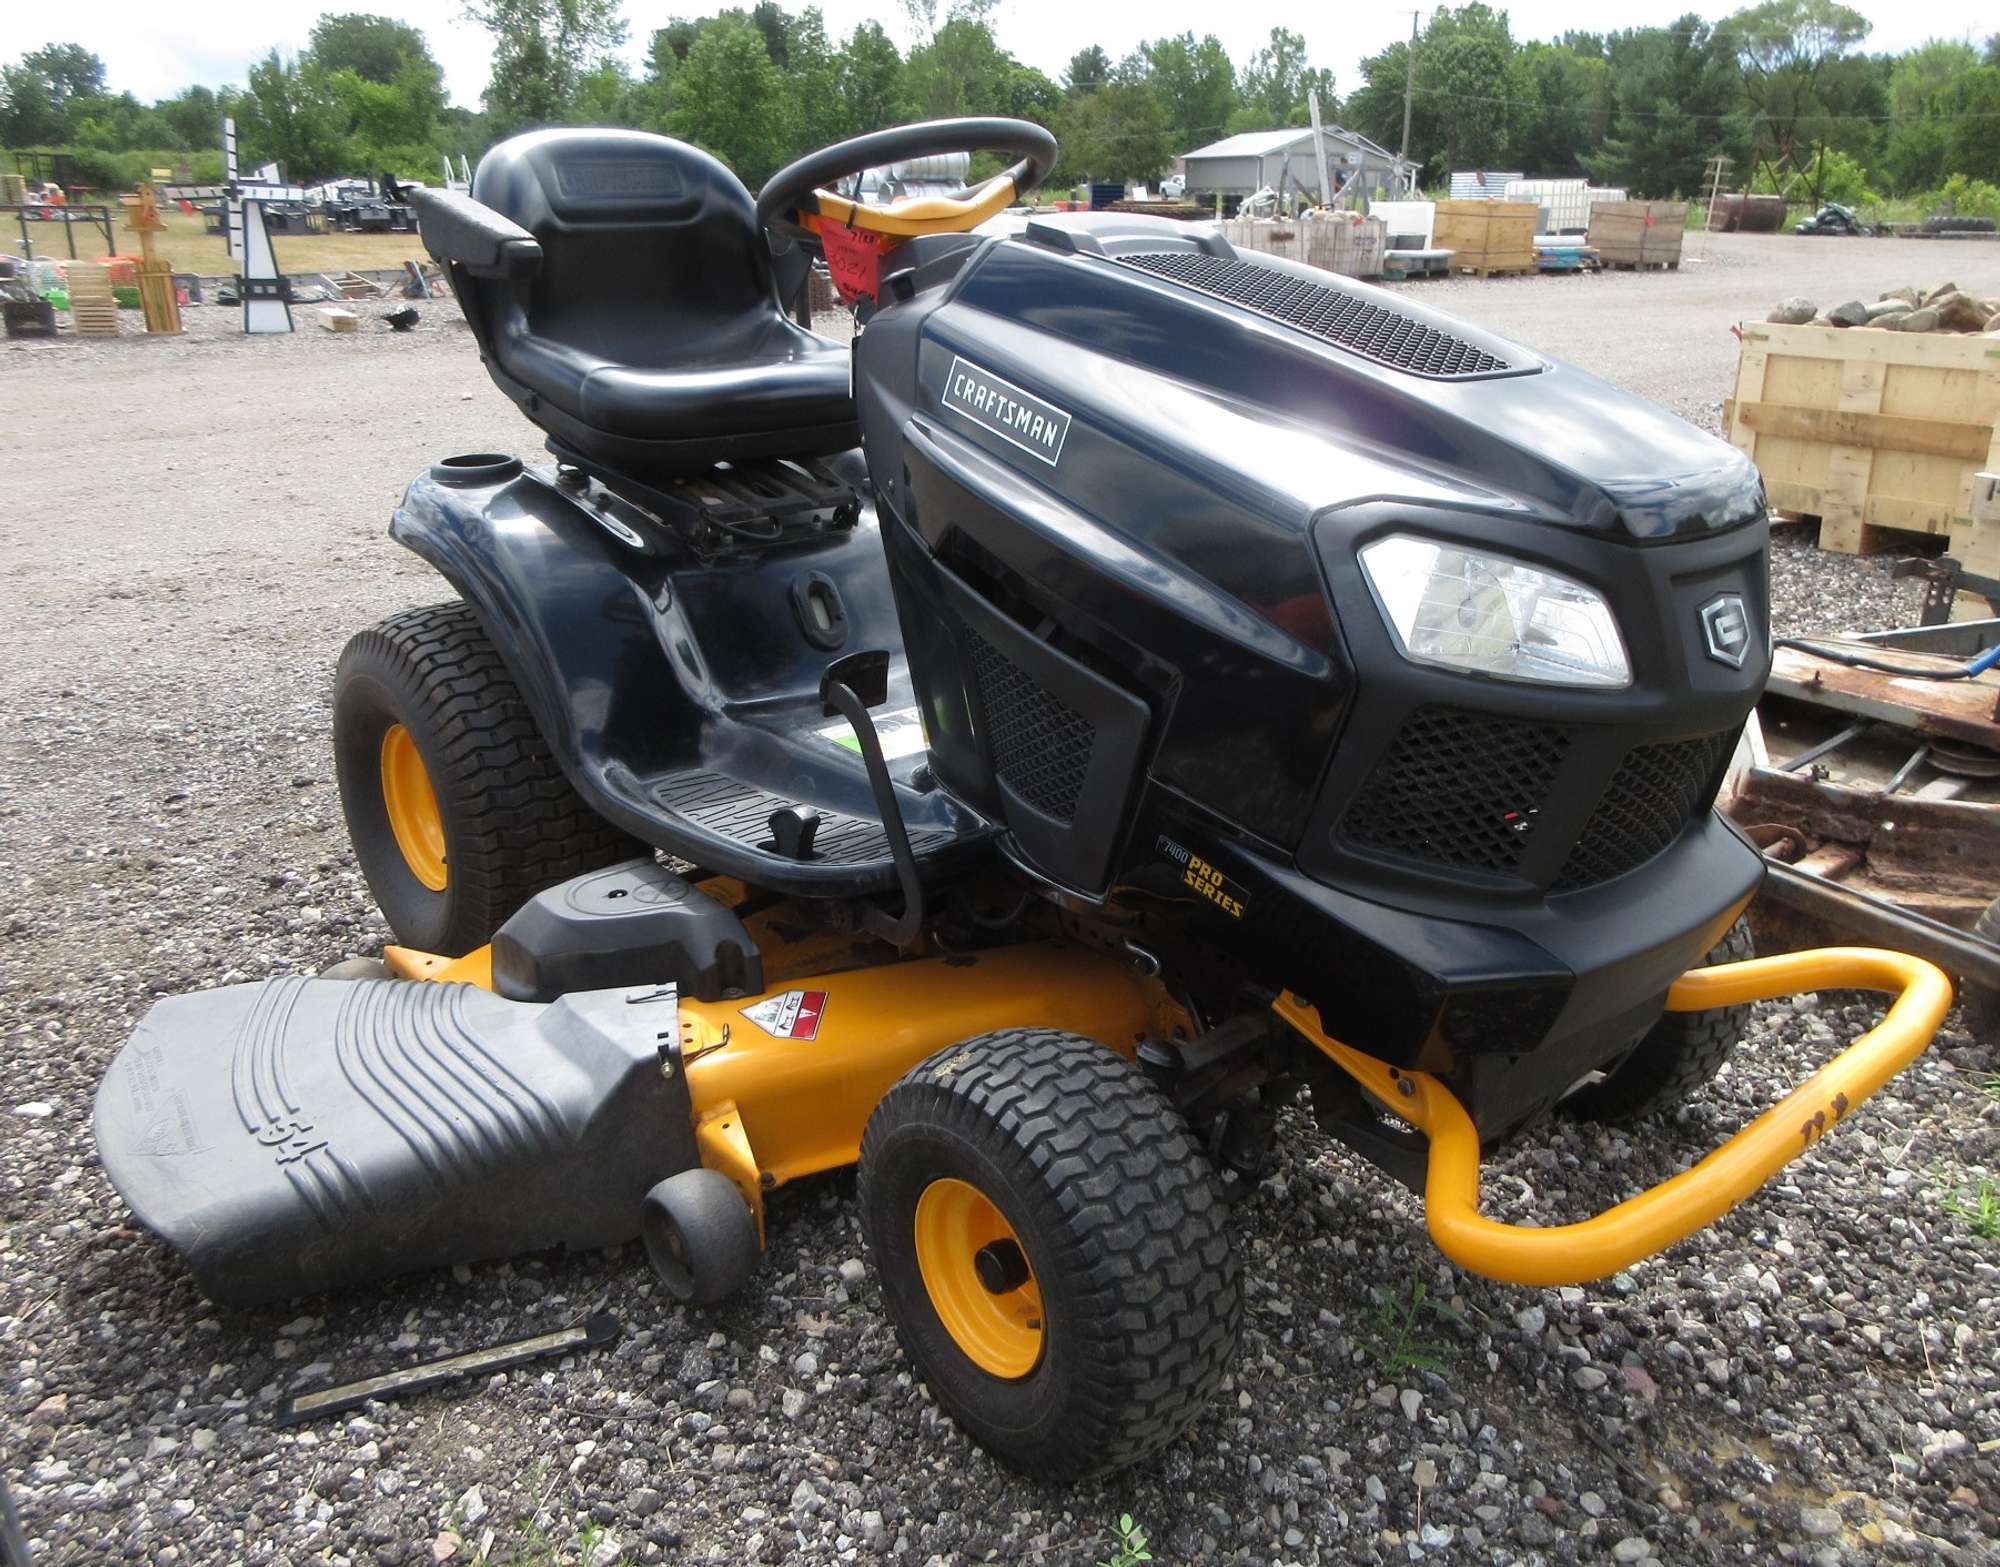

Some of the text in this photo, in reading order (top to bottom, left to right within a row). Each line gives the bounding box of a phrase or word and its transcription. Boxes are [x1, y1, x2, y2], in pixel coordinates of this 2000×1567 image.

[953, 373, 1058, 448] CRAFTSMAN
[1164, 840, 1223, 887] 7400 PRO
[1183, 869, 1243, 918] SERIES
